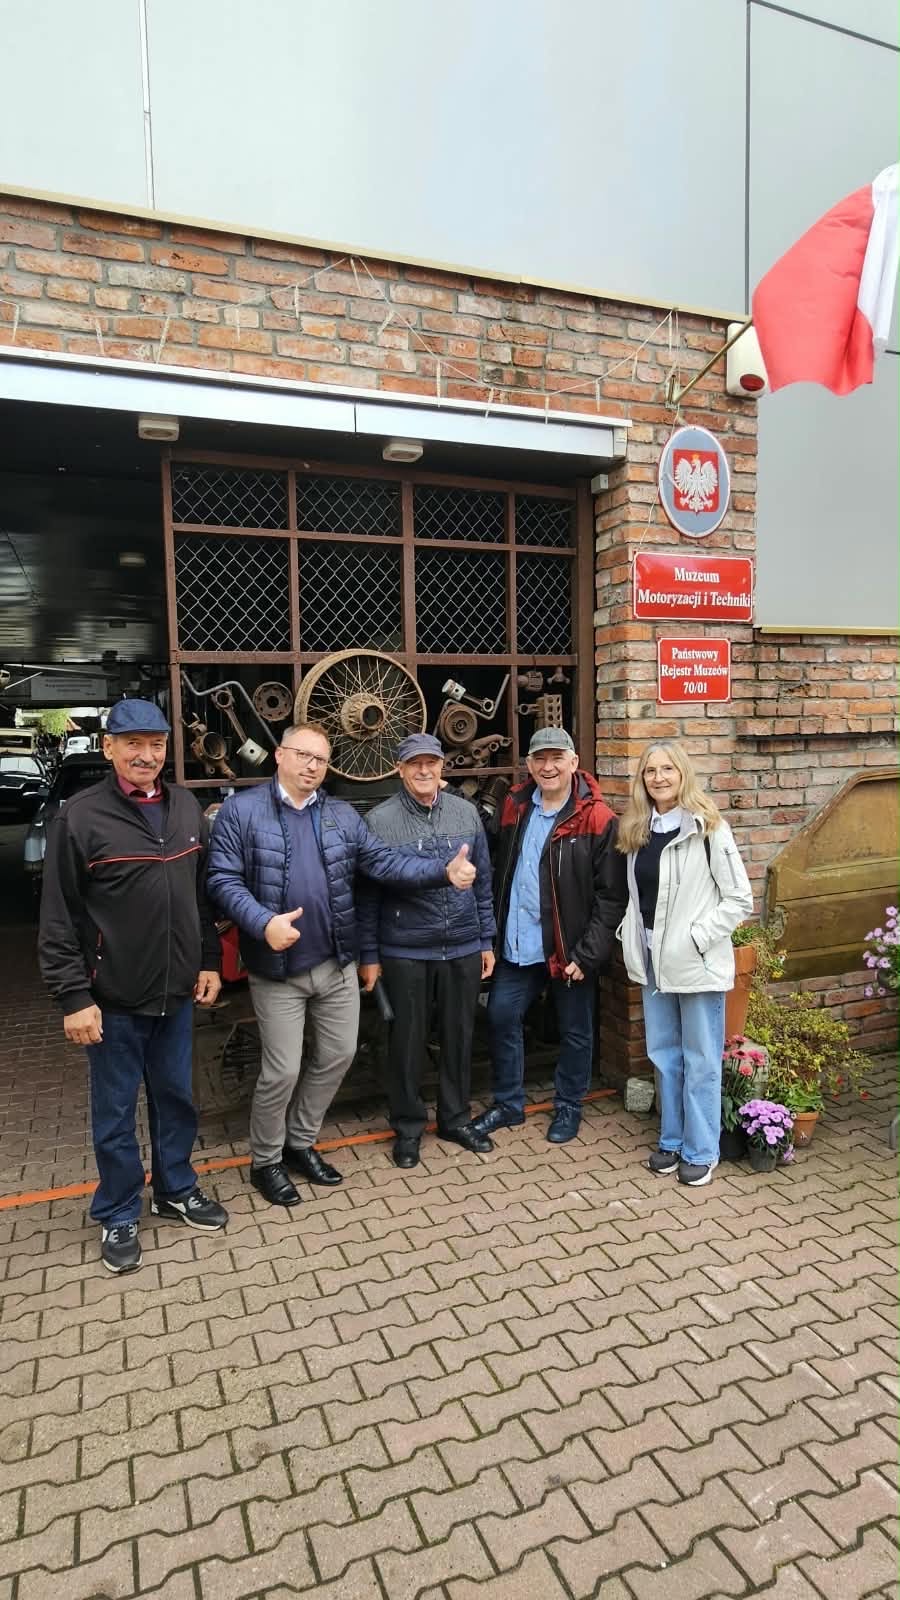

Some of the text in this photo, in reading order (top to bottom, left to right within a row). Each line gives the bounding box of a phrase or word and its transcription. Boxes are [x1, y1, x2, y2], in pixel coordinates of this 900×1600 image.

[674, 567, 720, 583] Muzeum
[638, 589, 751, 608] Motoryzacji i Techniki
[672, 647, 719, 662] Państwowy
[661, 664, 729, 679] Rejestr Muzeów
[683, 681, 707, 694] 70/01
